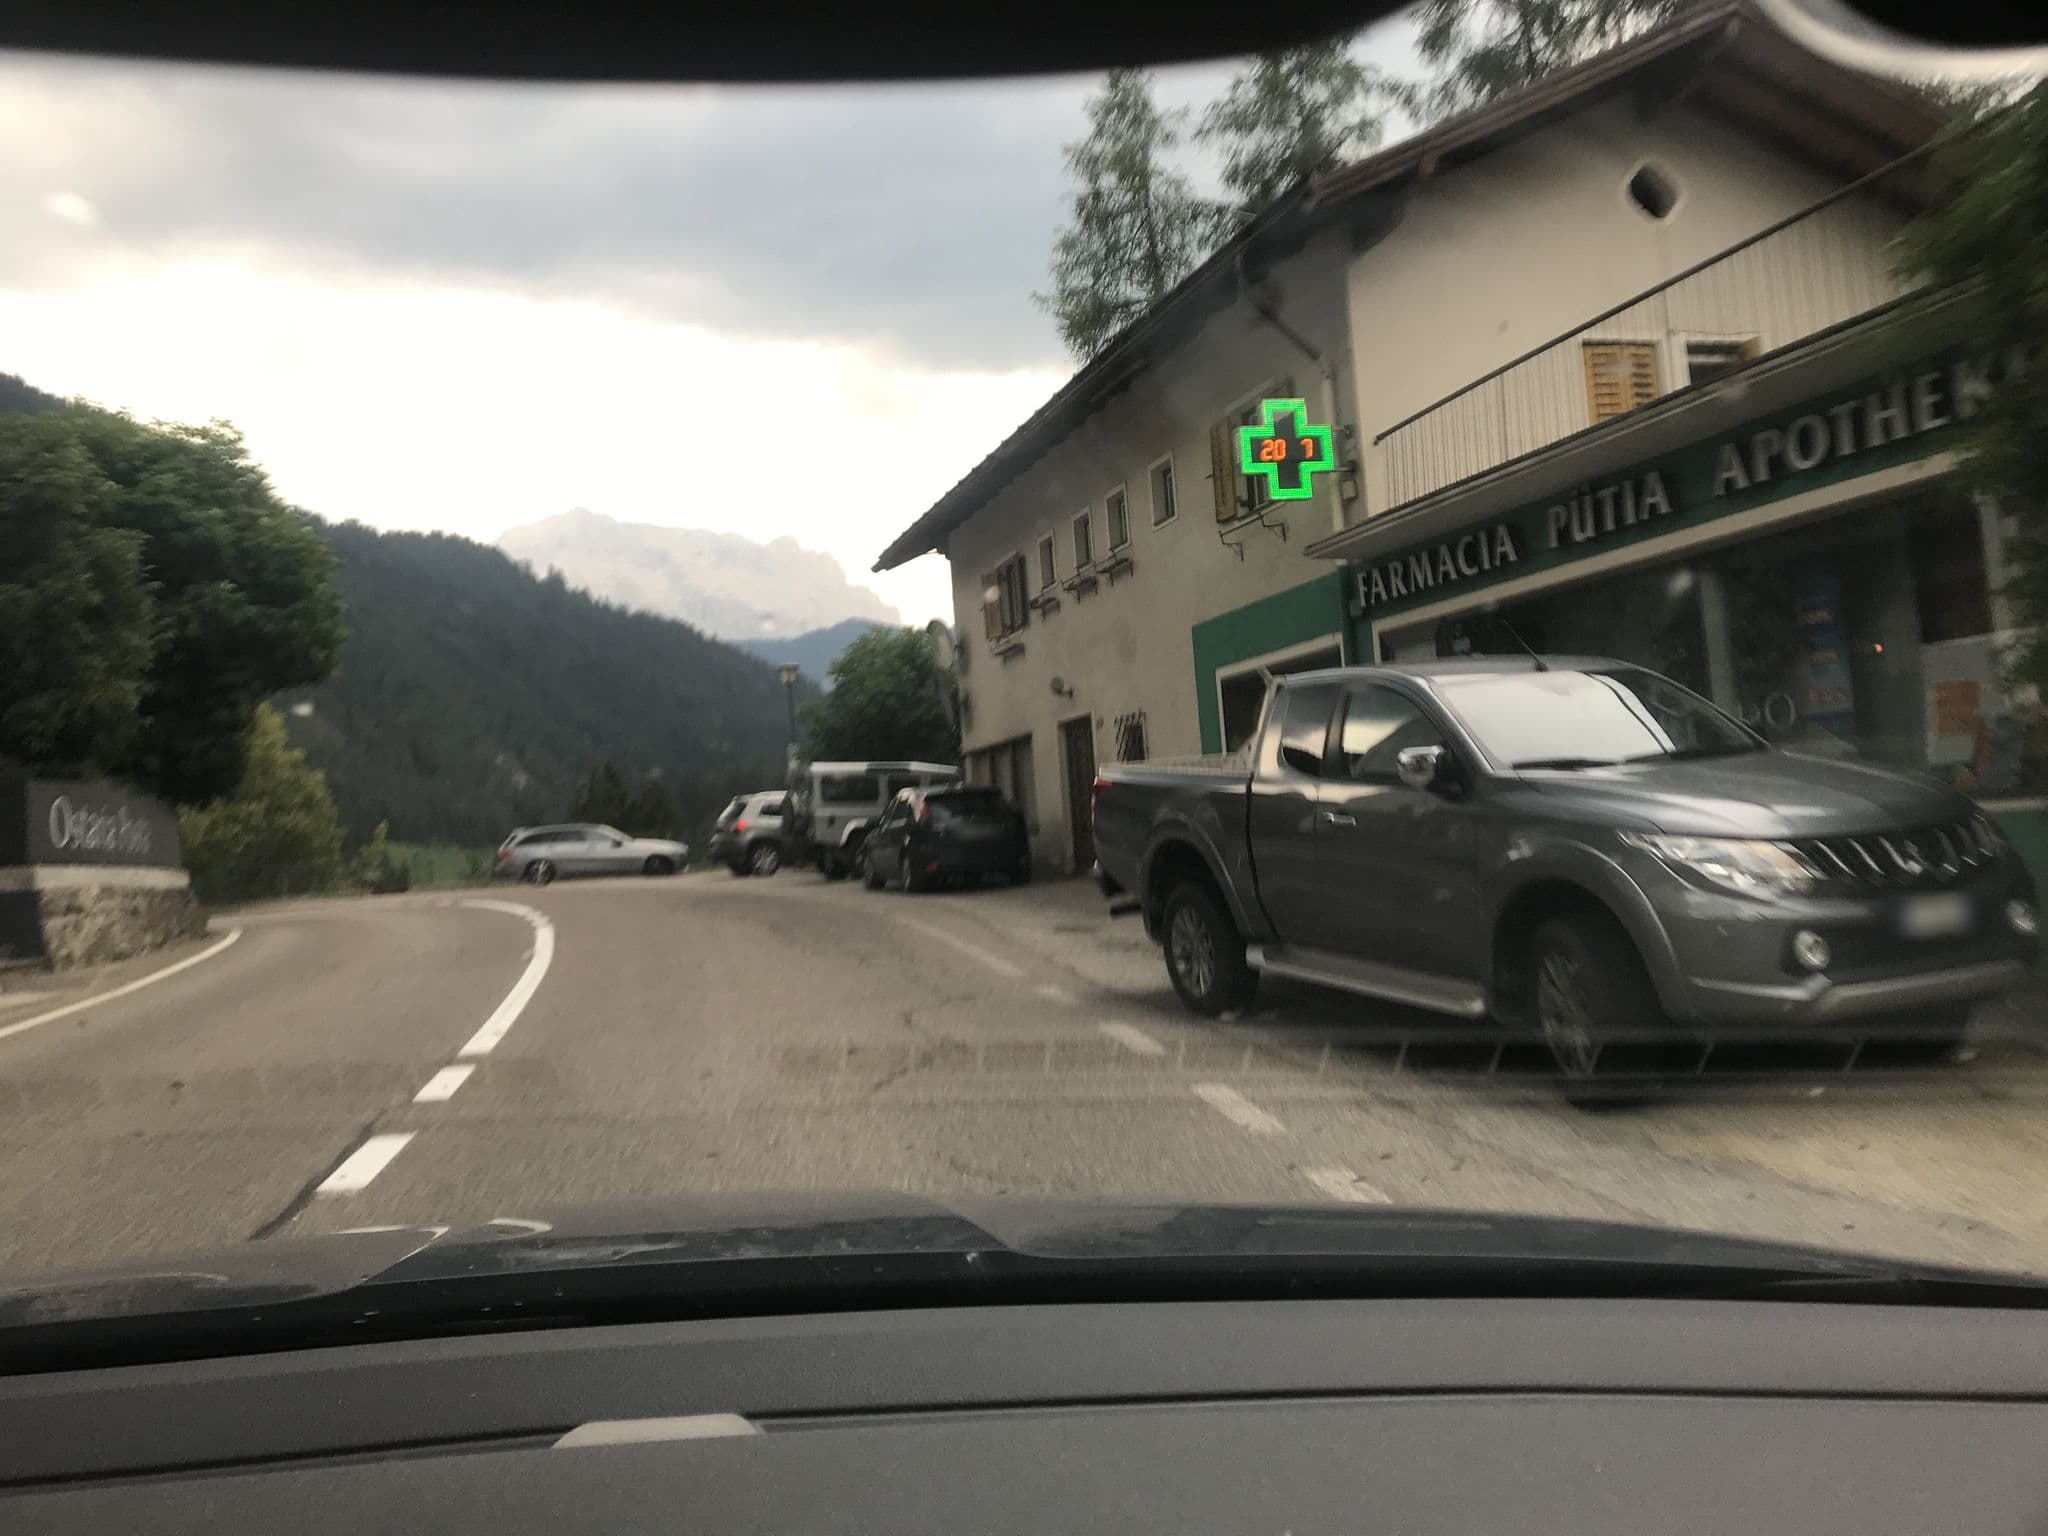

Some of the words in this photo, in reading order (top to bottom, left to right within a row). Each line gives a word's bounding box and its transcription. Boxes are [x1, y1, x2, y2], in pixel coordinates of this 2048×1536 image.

[1260, 439, 1286, 462] 20
[1357, 523, 1518, 607] FARMACIA
[1549, 471, 1673, 548] PÜTIA
